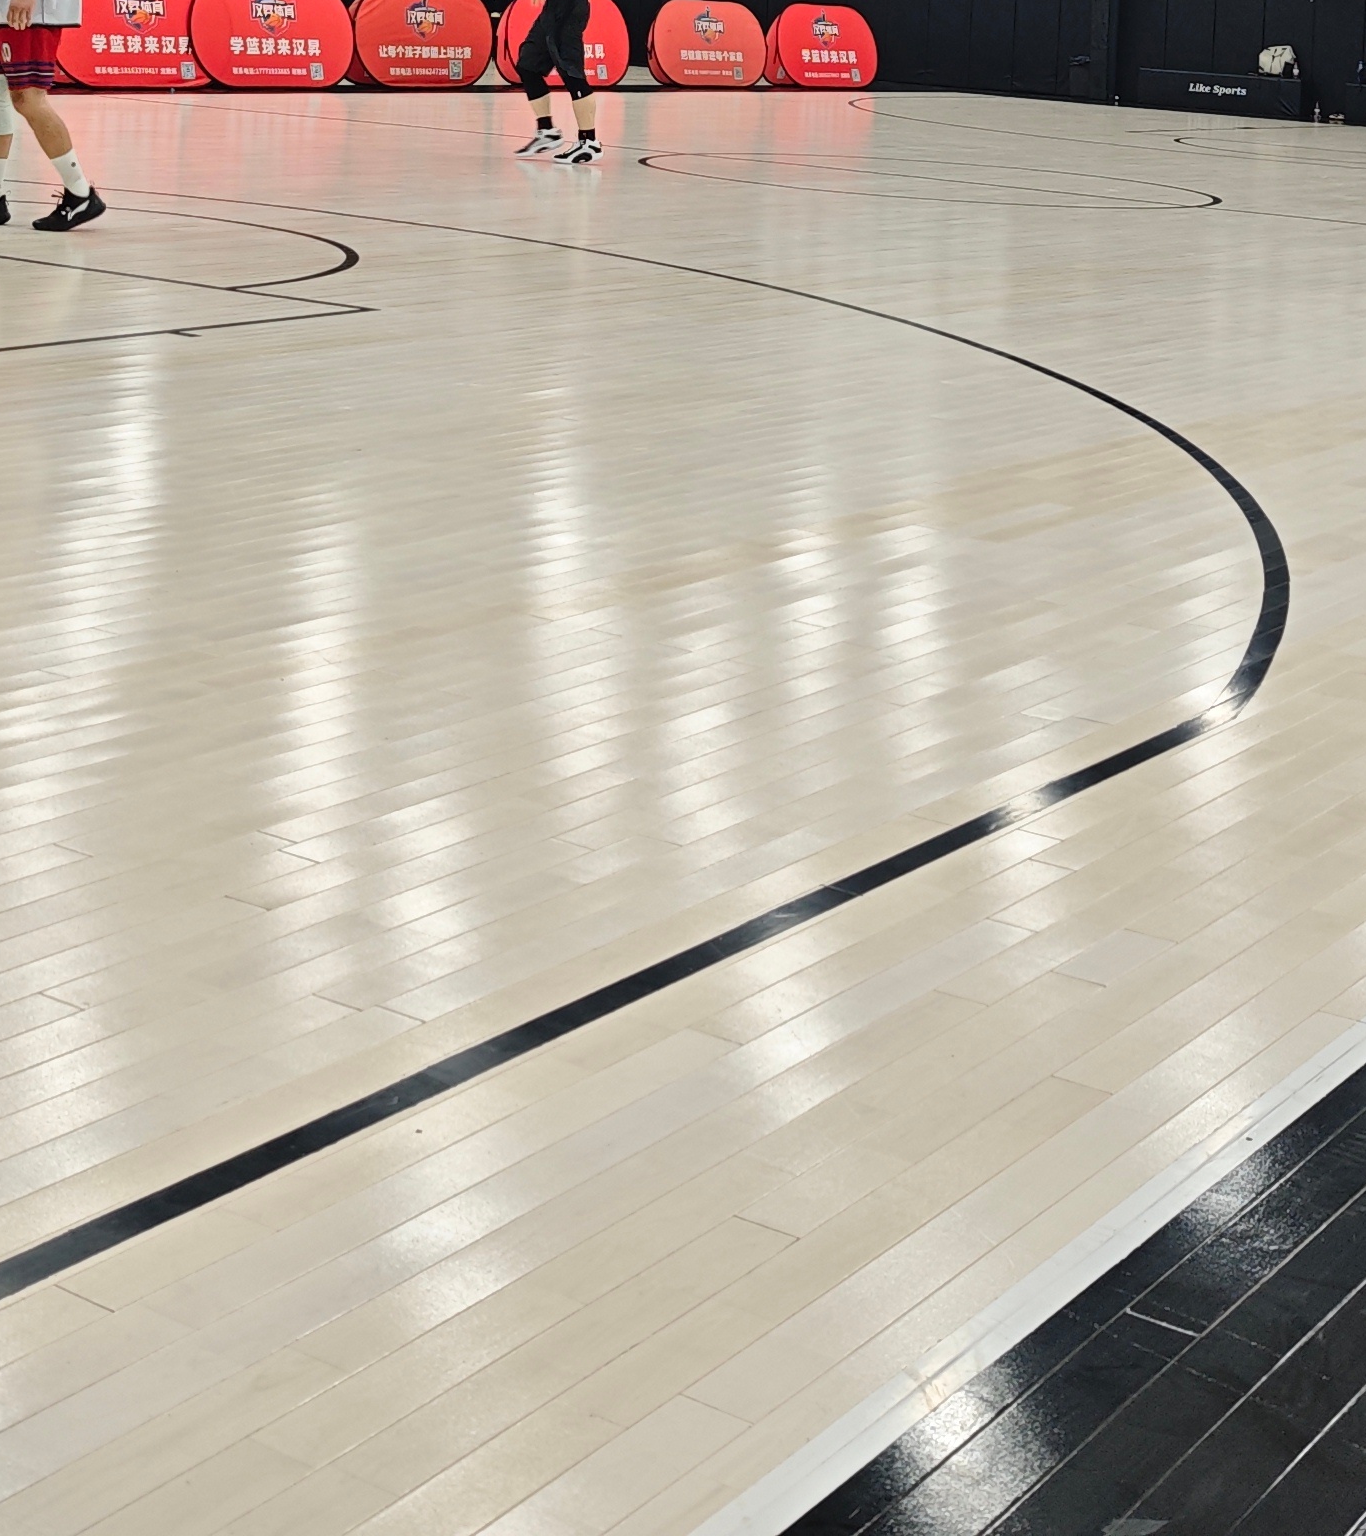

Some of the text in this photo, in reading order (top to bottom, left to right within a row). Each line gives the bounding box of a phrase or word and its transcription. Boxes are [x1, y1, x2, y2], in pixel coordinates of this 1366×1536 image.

[229, 36, 322, 57] 学篮球来汉昇
[1188, 82, 1247, 97] Like Sports
